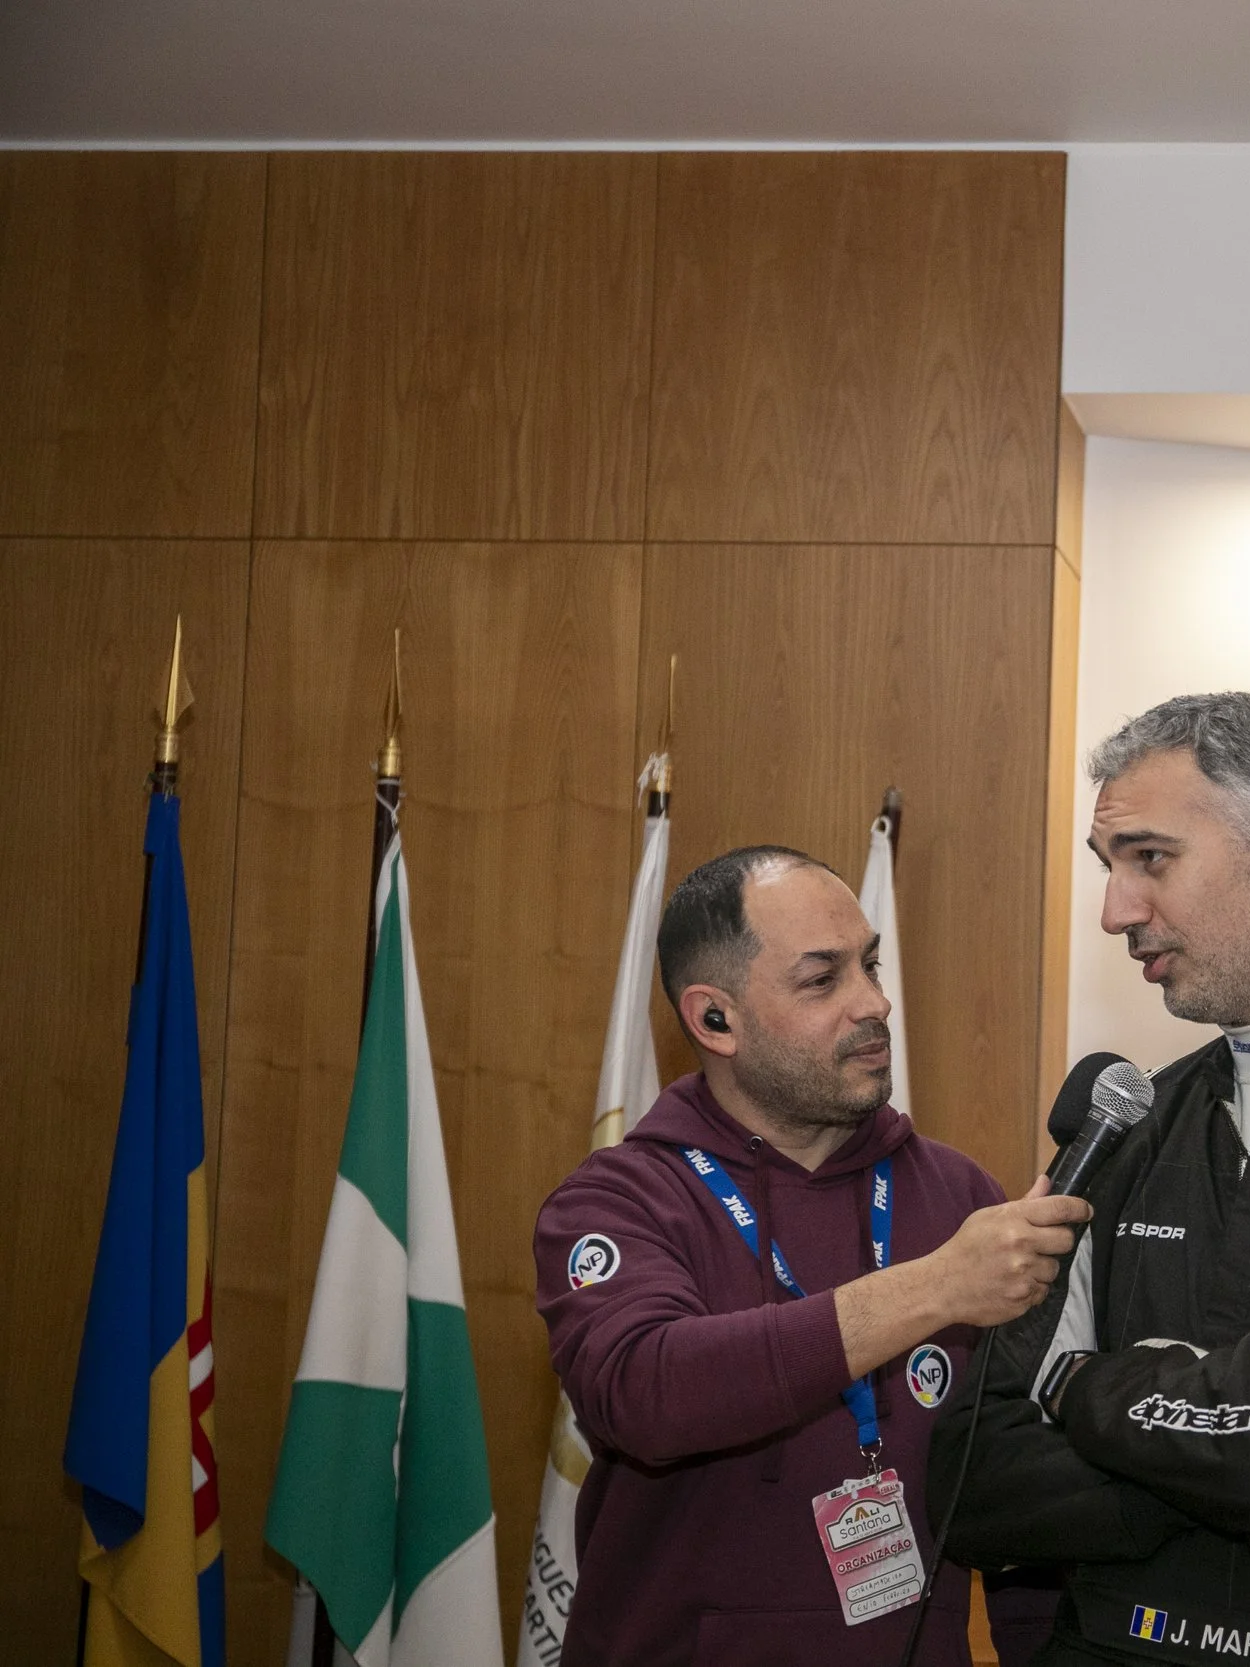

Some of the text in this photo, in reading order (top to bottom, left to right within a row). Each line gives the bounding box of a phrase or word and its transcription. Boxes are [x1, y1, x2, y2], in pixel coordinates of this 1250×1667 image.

[684, 1148, 716, 1176] FPAK
[874, 1173, 888, 1212] FPAK
[721, 1194, 755, 1227] FPAK
[577, 1251, 603, 1278] NP
[919, 1367, 942, 1386] NP
[840, 1514, 891, 1539] Santana
[846, 1507, 880, 1525] RALI
[837, 1539, 911, 1572] ORGANIZAÇÃO
[1169, 1618, 1190, 1647] J.
